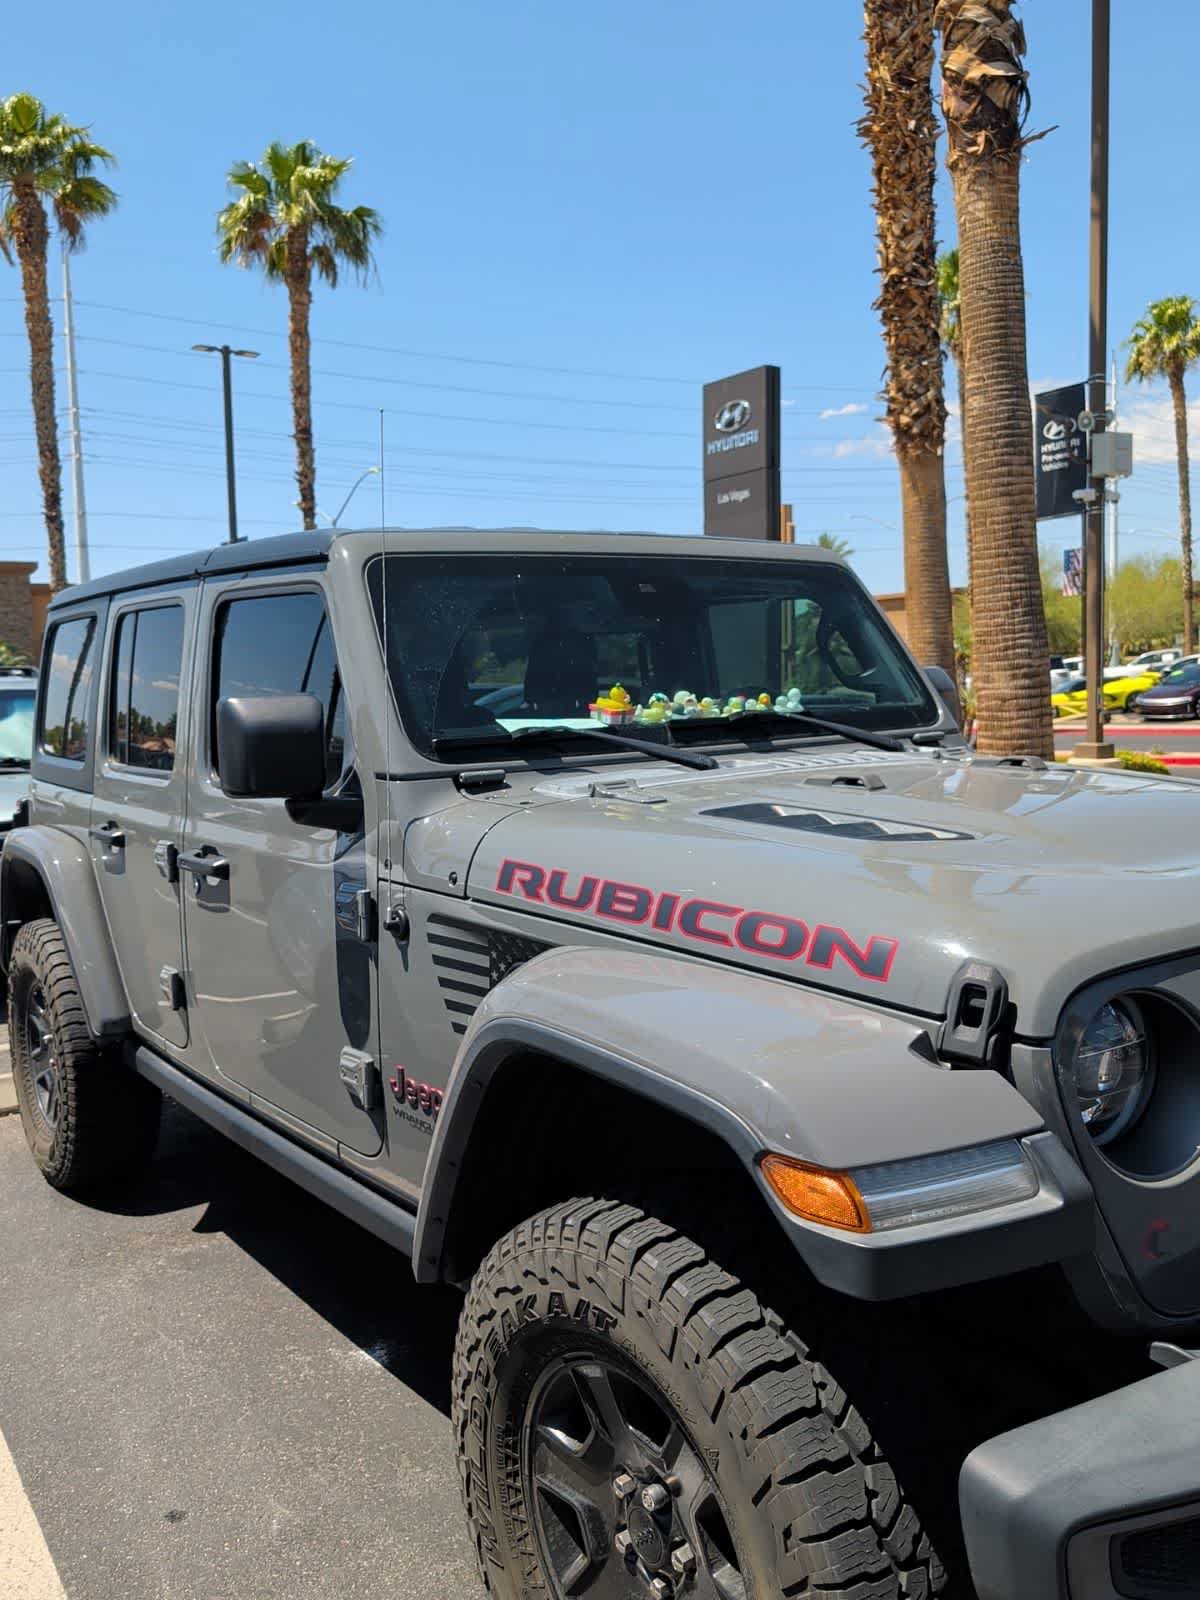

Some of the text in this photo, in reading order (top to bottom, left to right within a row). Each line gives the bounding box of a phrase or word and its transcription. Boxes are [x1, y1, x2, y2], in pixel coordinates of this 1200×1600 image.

[707, 429, 759, 455] HYUNDAI
[1041, 438, 1080, 453] HYUNAI
[496, 857, 900, 983] RUBICON
[387, 1063, 445, 1122] Jeep
